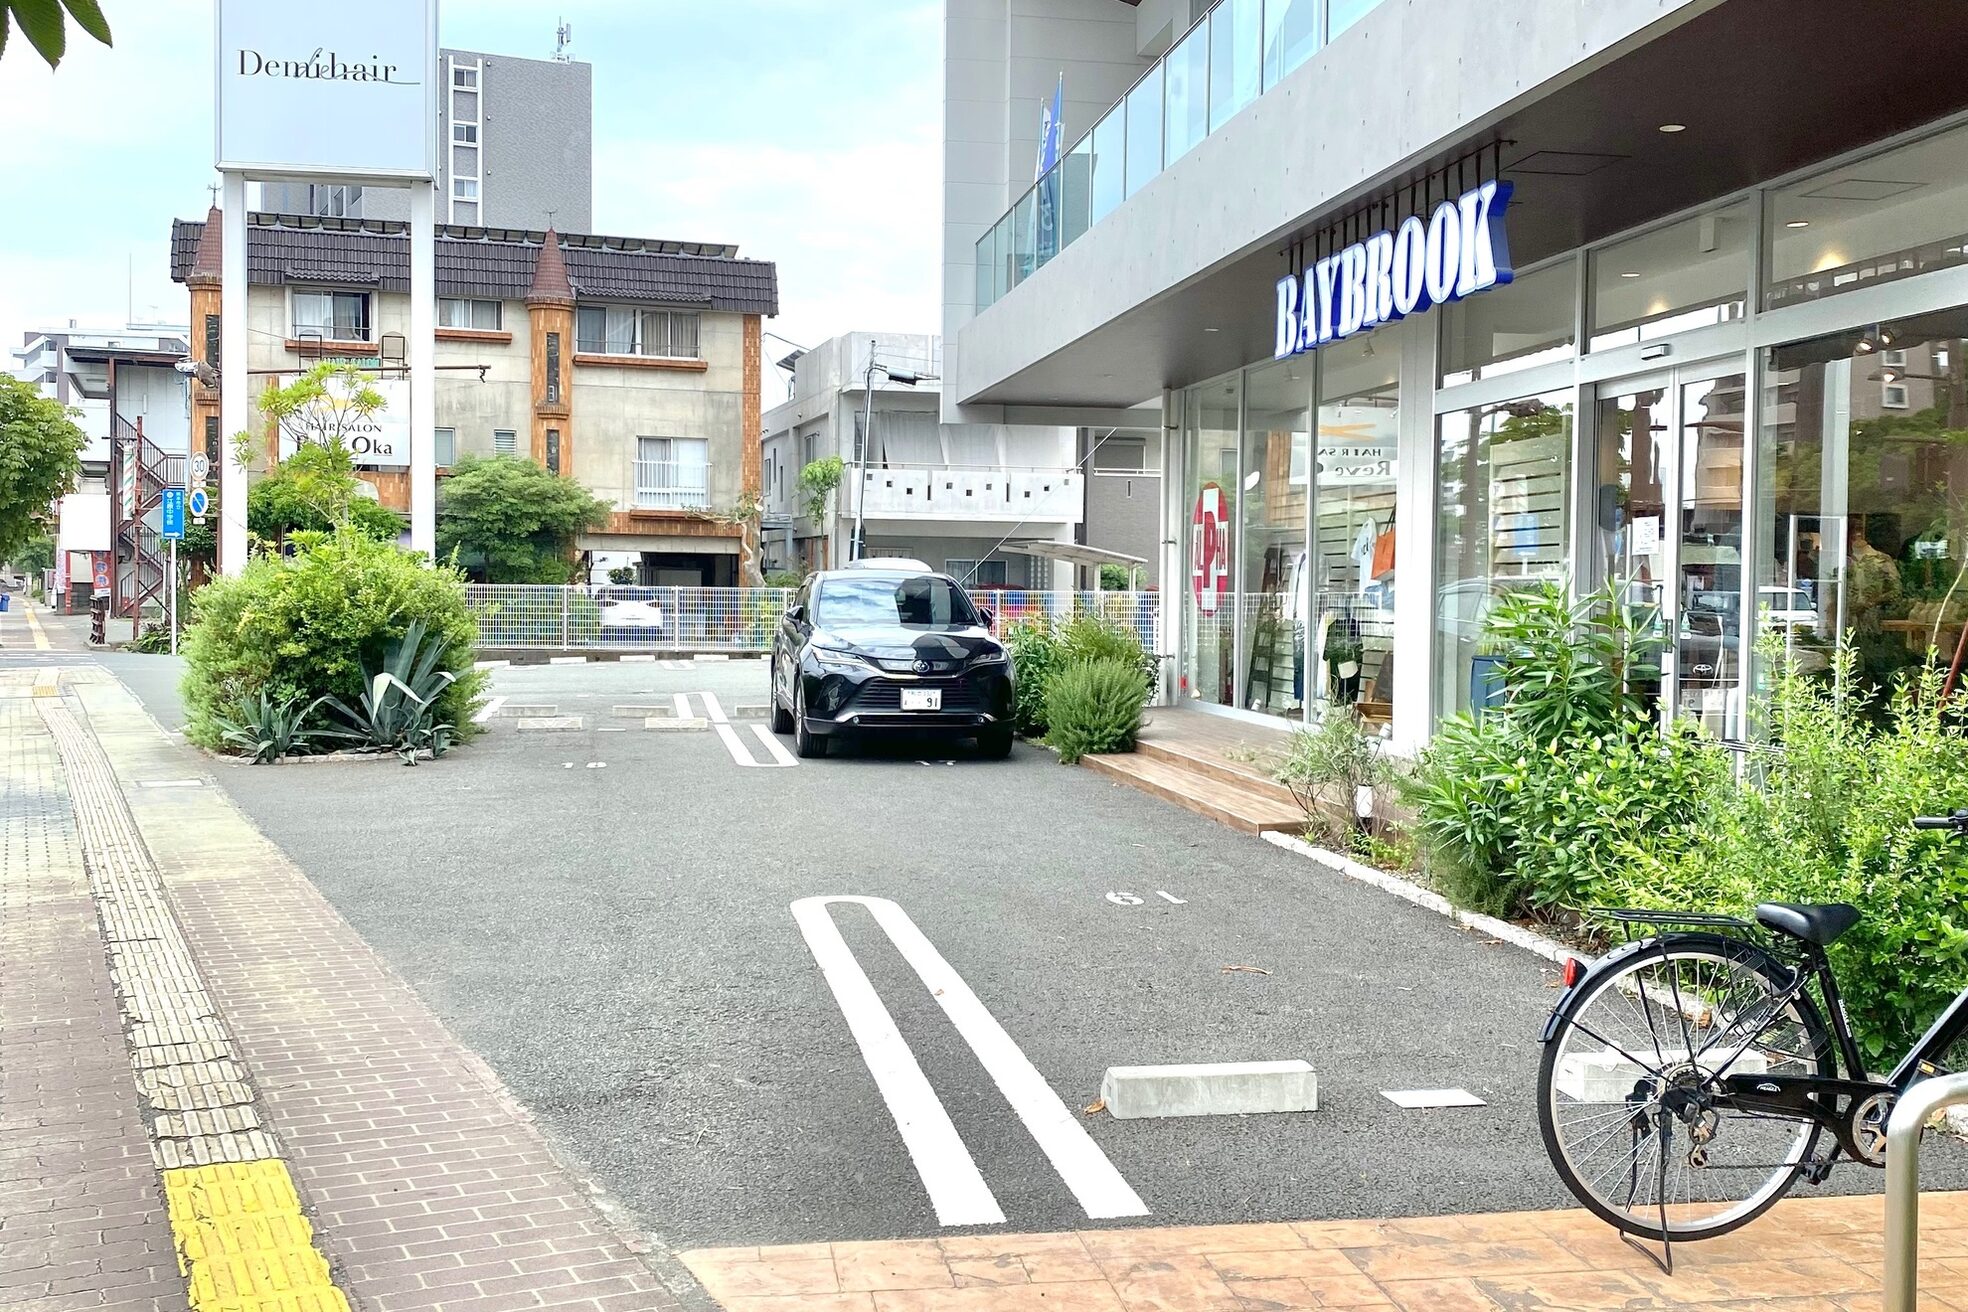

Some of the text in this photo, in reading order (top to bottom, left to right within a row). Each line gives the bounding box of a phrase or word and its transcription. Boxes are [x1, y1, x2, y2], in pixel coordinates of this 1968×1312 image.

[1274, 179, 1503, 360] BAYBROOK
[342, 423, 382, 432] SALON
[352, 436, 393, 456] Oka
[194, 460, 205, 472] 30
